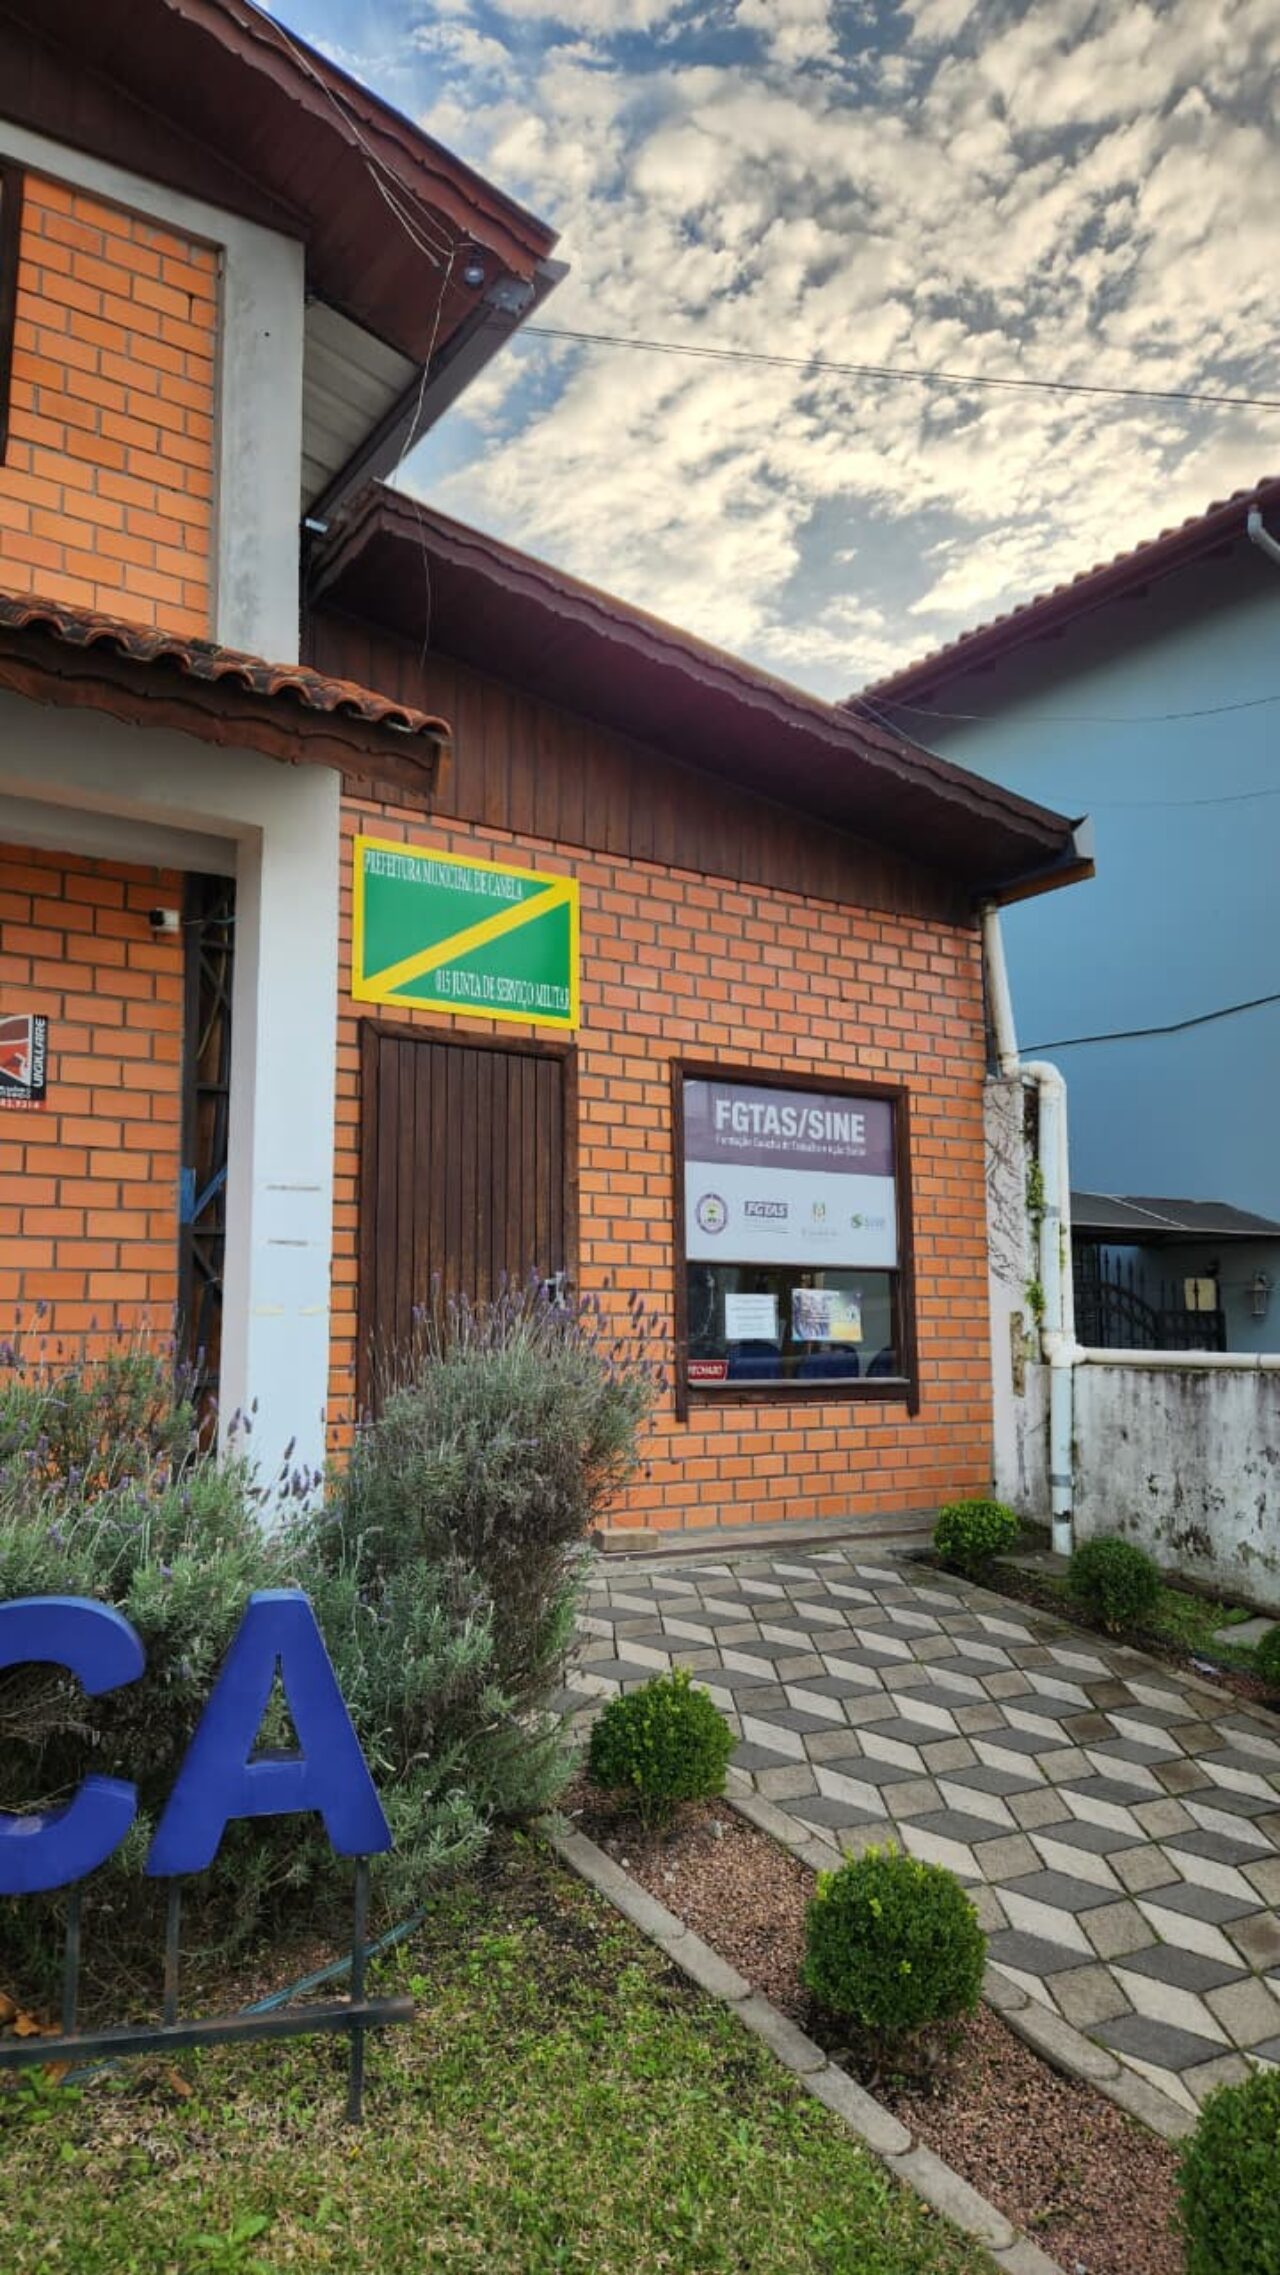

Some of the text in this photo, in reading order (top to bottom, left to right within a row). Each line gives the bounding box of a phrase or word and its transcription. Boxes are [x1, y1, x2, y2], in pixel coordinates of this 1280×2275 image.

[365, 850, 523, 901] PREFEITURA MUNICIPAL DE CANELA
[452, 970, 481, 997] JUNTA
[482, 975, 496, 1000] DE
[496, 977, 534, 1009] SERVIÇO
[714, 1099, 866, 1144] FGTAS/SINE
[746, 1202, 787, 1217] FGTAS
